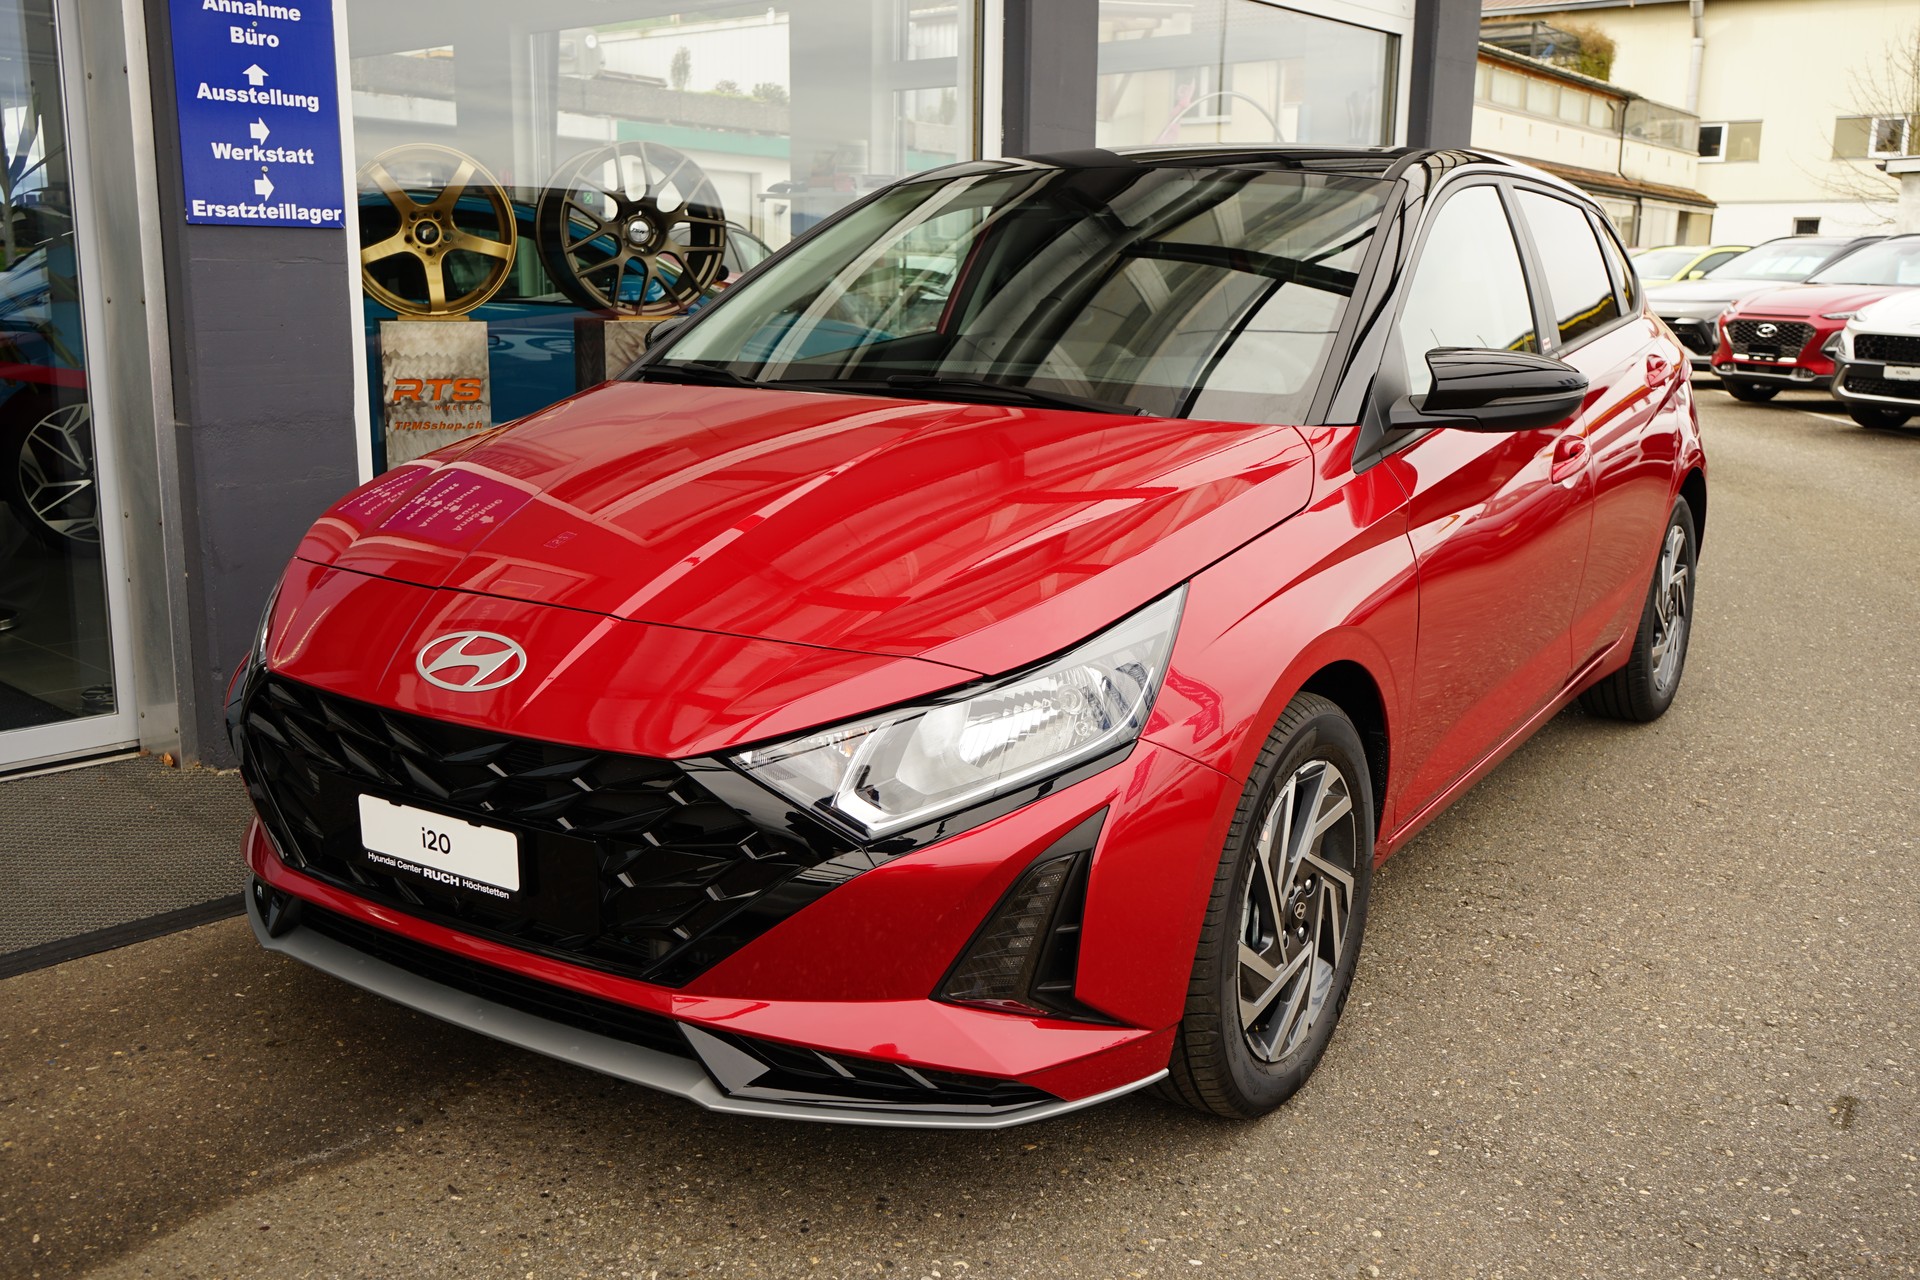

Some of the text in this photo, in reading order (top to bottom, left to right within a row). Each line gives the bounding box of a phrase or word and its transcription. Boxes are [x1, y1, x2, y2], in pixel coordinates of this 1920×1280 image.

[202, 0, 301, 21] Annahme
[229, 26, 280, 48] Büro
[196, 82, 320, 113] Ausstellung
[211, 142, 315, 165] Werkstatt
[192, 199, 343, 225] Ersatzteillager
[393, 378, 481, 401] RTS
[395, 420, 484, 432] TPMSshop.ch
[421, 827, 451, 854] i20
[367, 851, 510, 899] Hyundai Center RUCH Höchstetten
